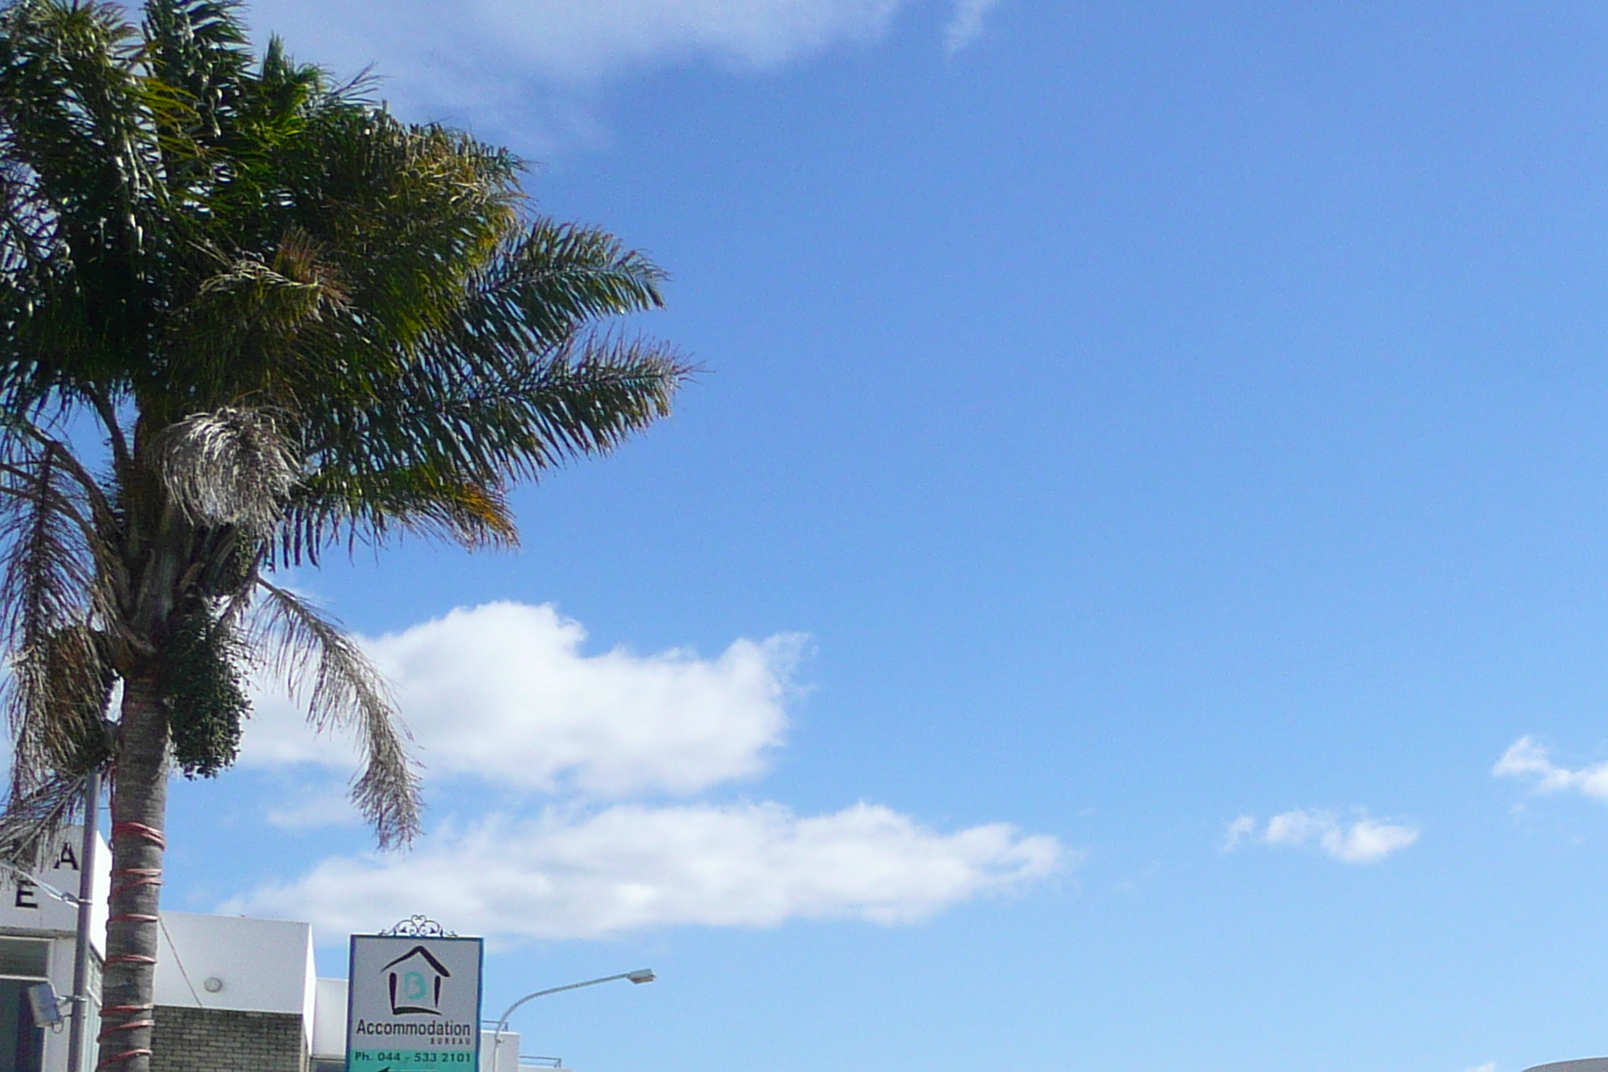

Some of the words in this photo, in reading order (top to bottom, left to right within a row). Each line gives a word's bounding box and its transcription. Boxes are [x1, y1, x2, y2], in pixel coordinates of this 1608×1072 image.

[356, 1019, 471, 1036] Accommodation
[430, 1037, 471, 1046] BUREAU
[355, 1051, 373, 1063] Ph.
[378, 1051, 400, 1062] 044
[414, 1052, 437, 1062] 533
[442, 1053, 471, 1063] 2101
